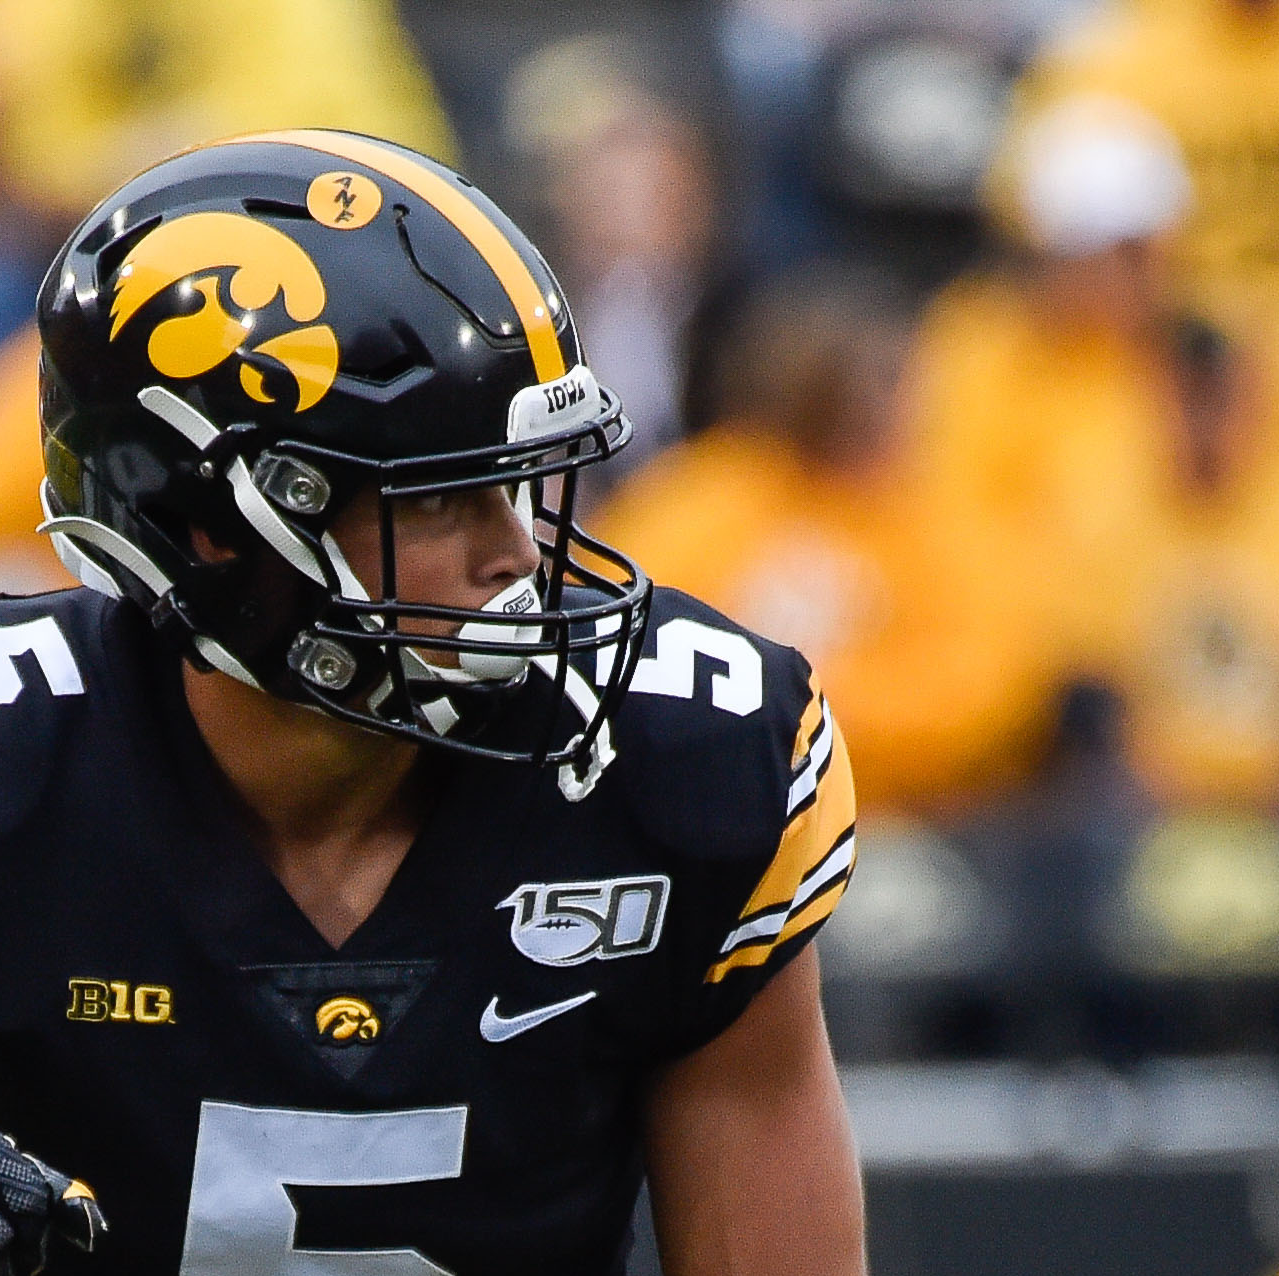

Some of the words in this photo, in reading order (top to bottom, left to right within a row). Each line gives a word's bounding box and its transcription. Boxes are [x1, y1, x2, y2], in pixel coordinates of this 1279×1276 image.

[333, 176, 357, 223] ANF
[542, 379, 586, 414] IOWA
[595, 616, 763, 718] 5
[509, 876, 670, 967] 150
